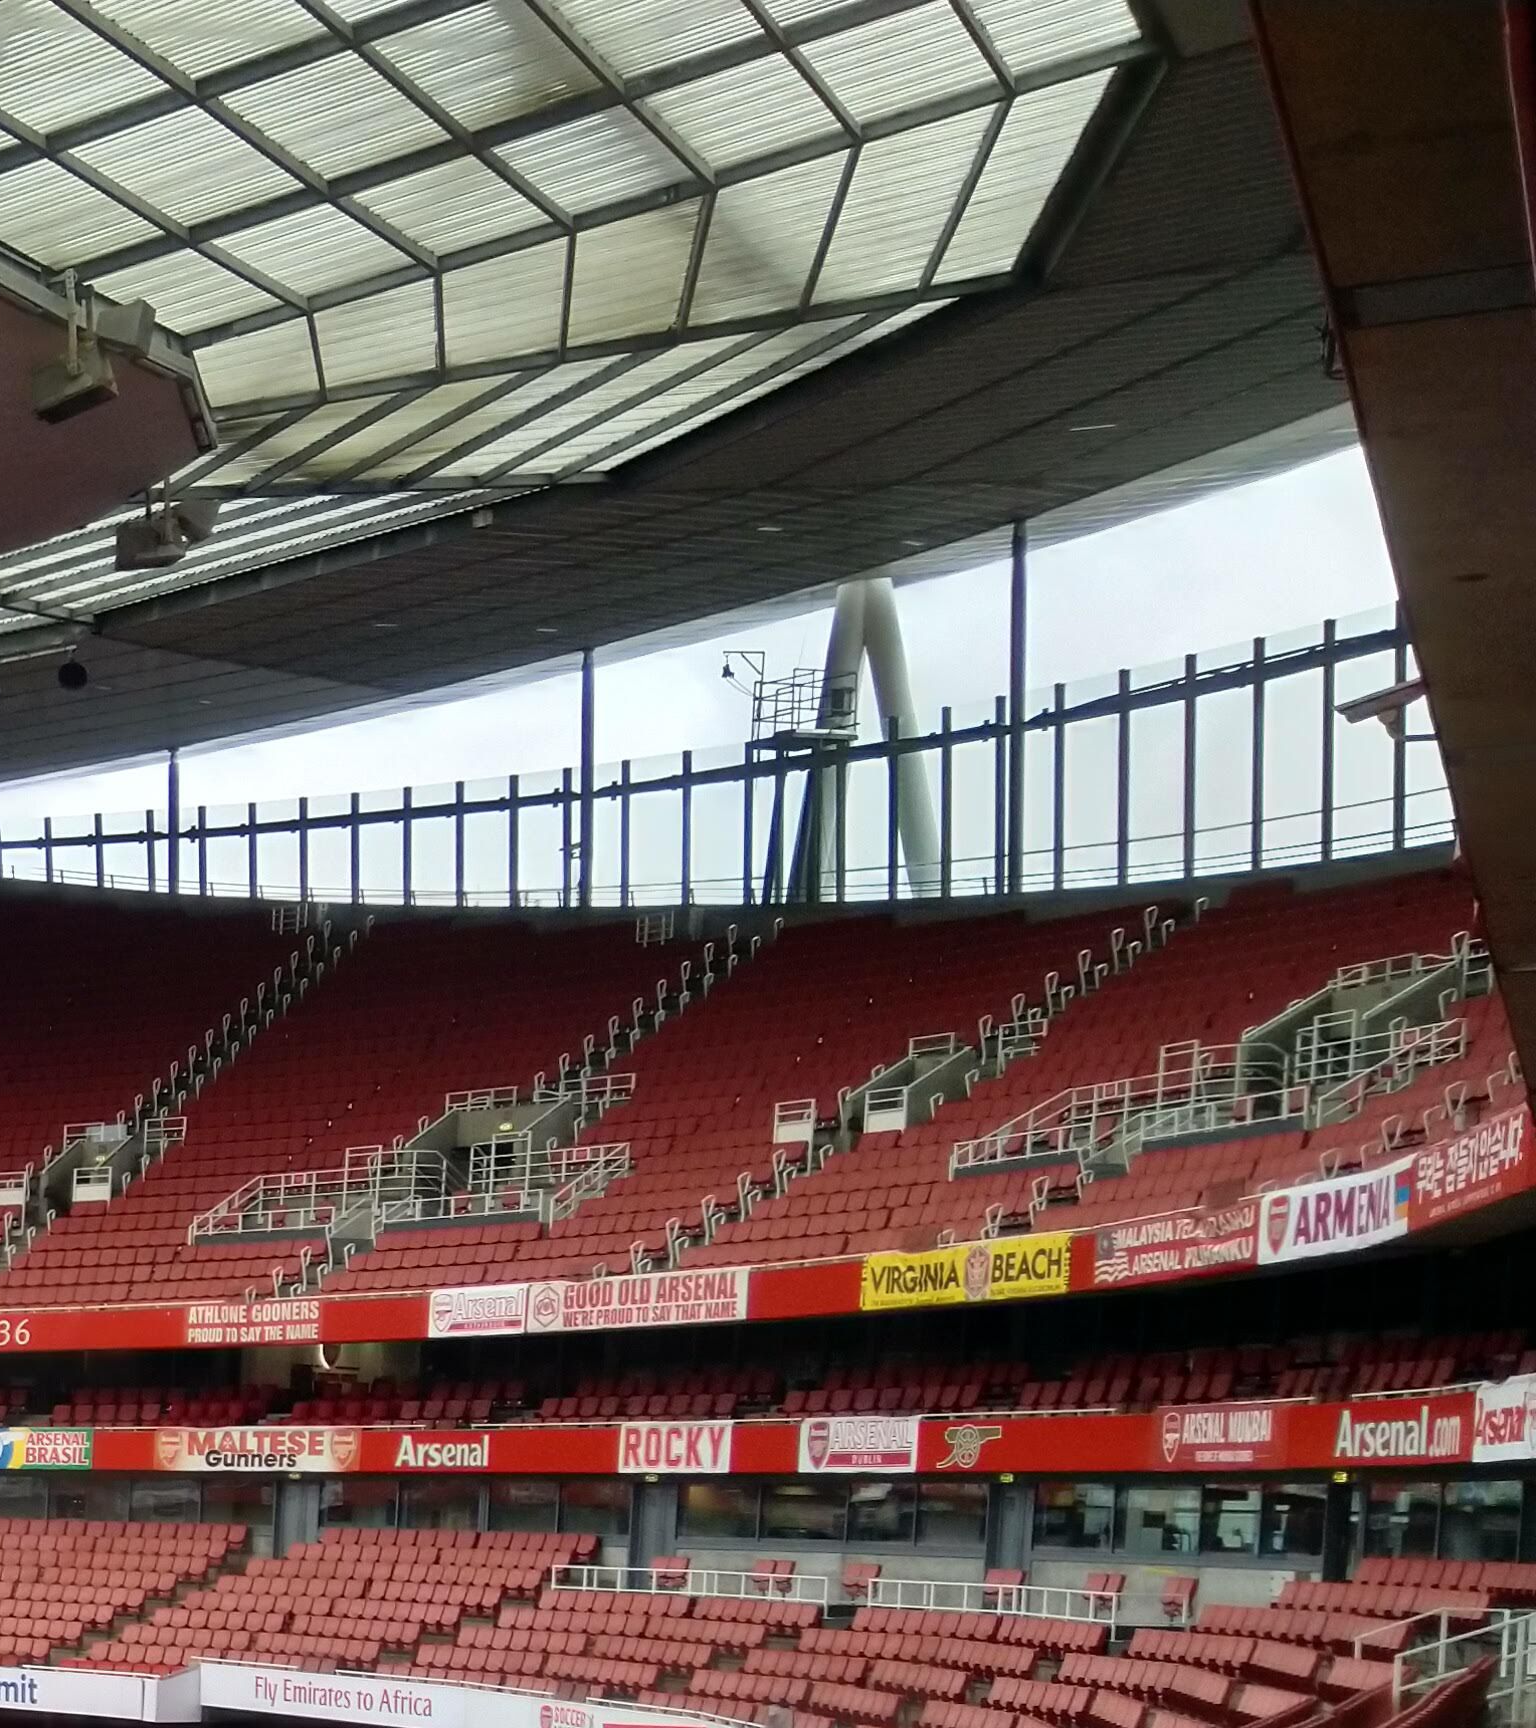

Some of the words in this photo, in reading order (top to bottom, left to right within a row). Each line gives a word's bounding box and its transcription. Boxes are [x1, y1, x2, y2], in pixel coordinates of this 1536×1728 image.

[1292, 1174, 1391, 1246] ARMENIA
[870, 1260, 961, 1294] VIRGINIA
[991, 1247, 1062, 1284] BEACH
[1129, 1248, 1182, 1276] ARSENAL
[452, 1288, 524, 1321] Arsenal
[564, 1280, 614, 1310] GOOD
[617, 1276, 651, 1307] OLD
[655, 1271, 737, 1303] ARSENAL
[188, 1305, 247, 1324] ATHLONE
[252, 1301, 319, 1322] GOONERS
[595, 1308, 634, 1324] PROUD
[635, 1307, 649, 1323] TO
[652, 1305, 672, 1322] SAY
[674, 1303, 702, 1320] THAT
[704, 1301, 737, 1318] NAME
[188, 1327, 223, 1343] PROUD
[226, 1327, 237, 1342] TO
[240, 1326, 262, 1341] SAY
[263, 1325, 283, 1340] THE
[286, 1324, 319, 1339] NAME
[26, 1431, 89, 1447] ARSENAL
[187, 1430, 325, 1456] MALTESE
[829, 1420, 914, 1450] ARSENAL
[1182, 1412, 1225, 1444] ARSENAL
[1333, 1404, 1461, 1458] Arsenal.com
[24, 1447, 88, 1465] BRASIL
[204, 1449, 297, 1468] Gunners
[394, 1434, 490, 1467] Arsenal
[622, 1426, 726, 1470] ROCKY
[254, 1675, 278, 1707] Fly
[283, 1679, 351, 1709] Emirates
[356, 1690, 373, 1711] to
[379, 1688, 432, 1718] Africa
